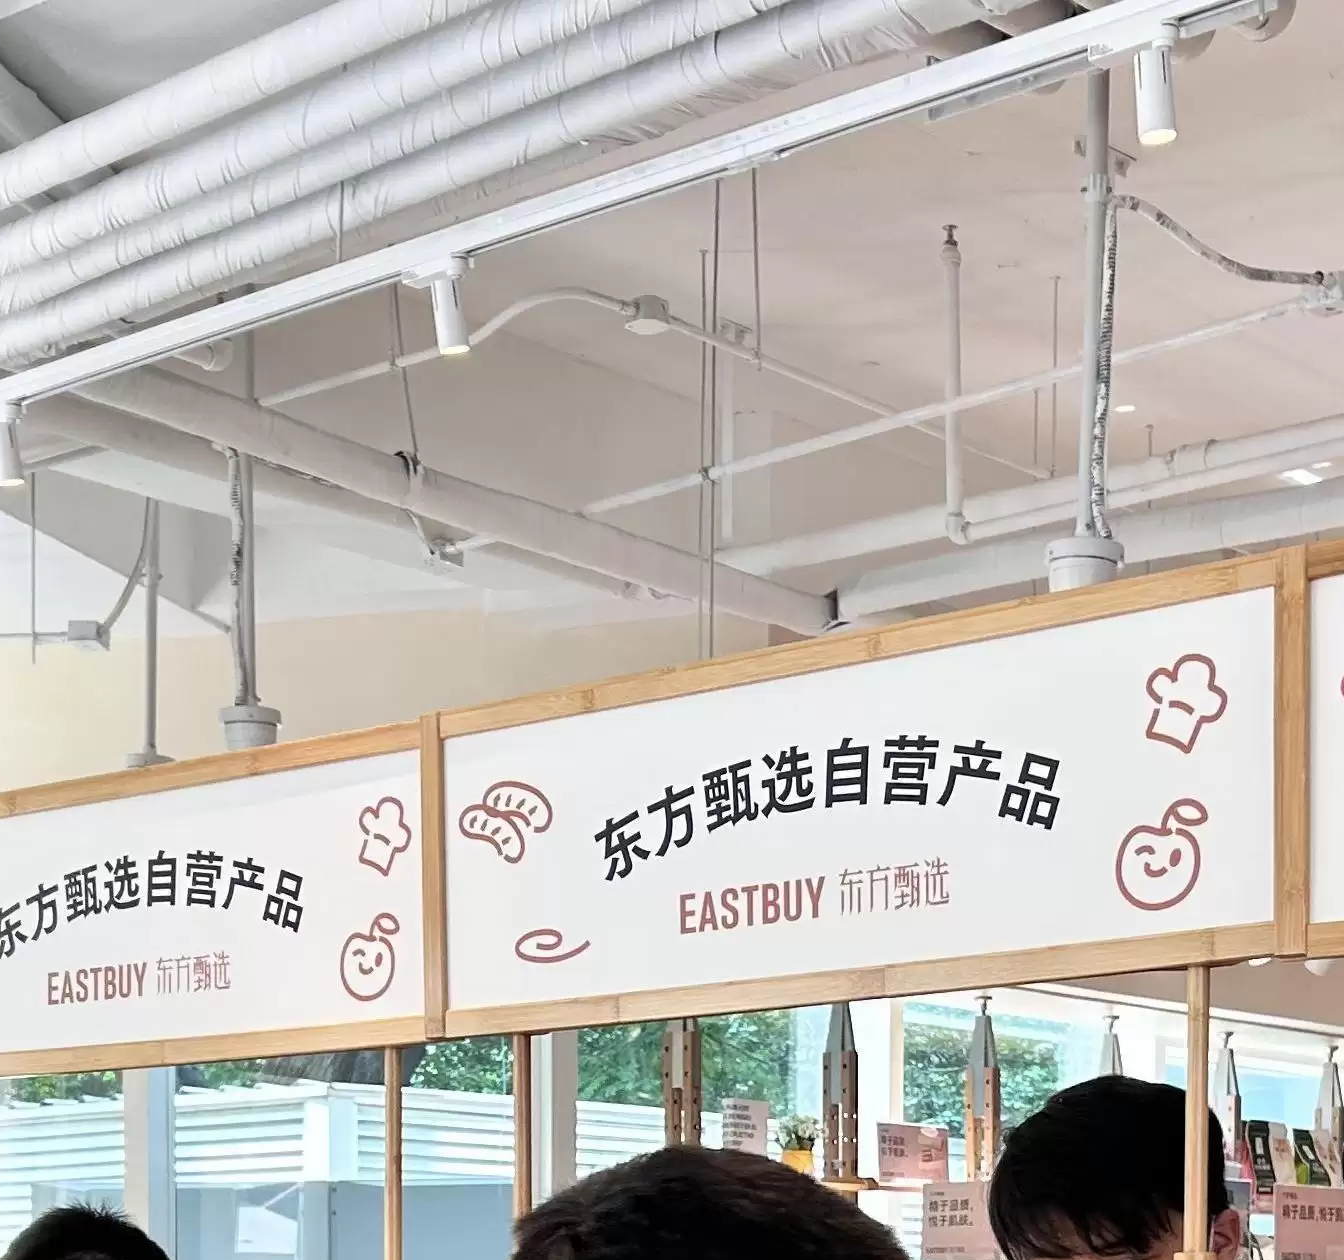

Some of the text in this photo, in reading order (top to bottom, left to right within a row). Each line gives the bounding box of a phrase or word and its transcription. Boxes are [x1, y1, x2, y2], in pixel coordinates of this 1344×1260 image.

[594, 734, 1061, 882] 东方甄选自营产品
[679, 857, 951, 934] EASTBUY 东方甄选
[47, 951, 232, 1007] EASTBUY 东方甄选
